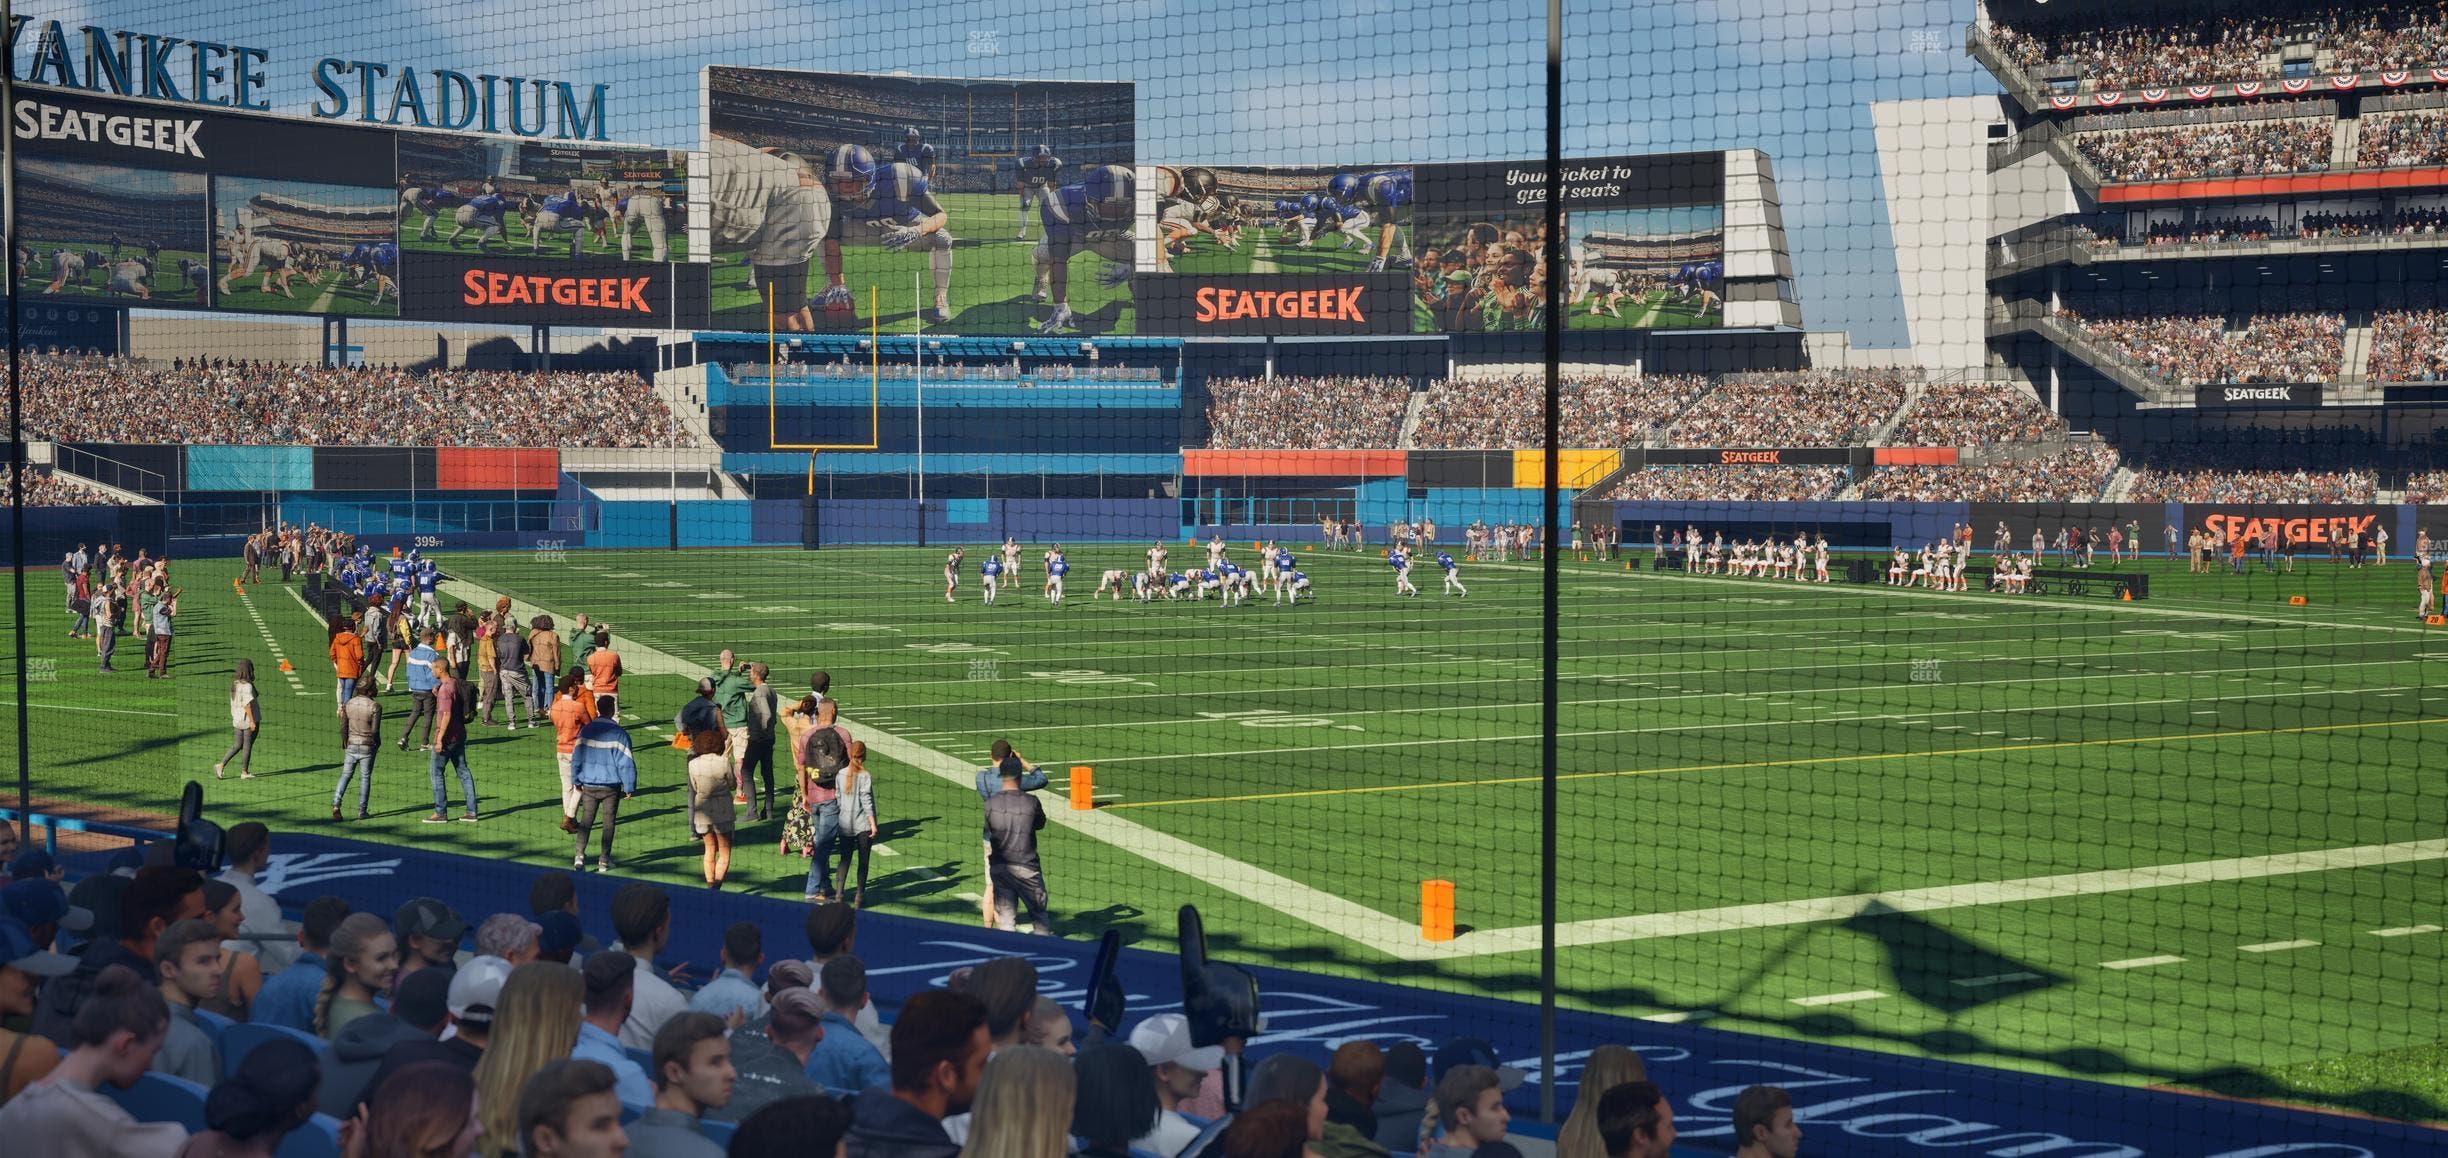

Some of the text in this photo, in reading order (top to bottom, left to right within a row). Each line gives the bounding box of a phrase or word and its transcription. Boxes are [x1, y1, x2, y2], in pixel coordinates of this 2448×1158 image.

[311, 57, 610, 141] STADIUM
[15, 99, 205, 159] SEATGEEK
[1560, 166, 1609, 182] icket
[1612, 165, 1632, 179] to
[1517, 182, 1621, 204] gret seats
[464, 269, 652, 313] SEATGEEK
[1196, 286, 1366, 323] SEATGEEK
[2224, 386, 2291, 402] SEATGEEK
[1721, 450, 1771, 464] SEATGEEK
